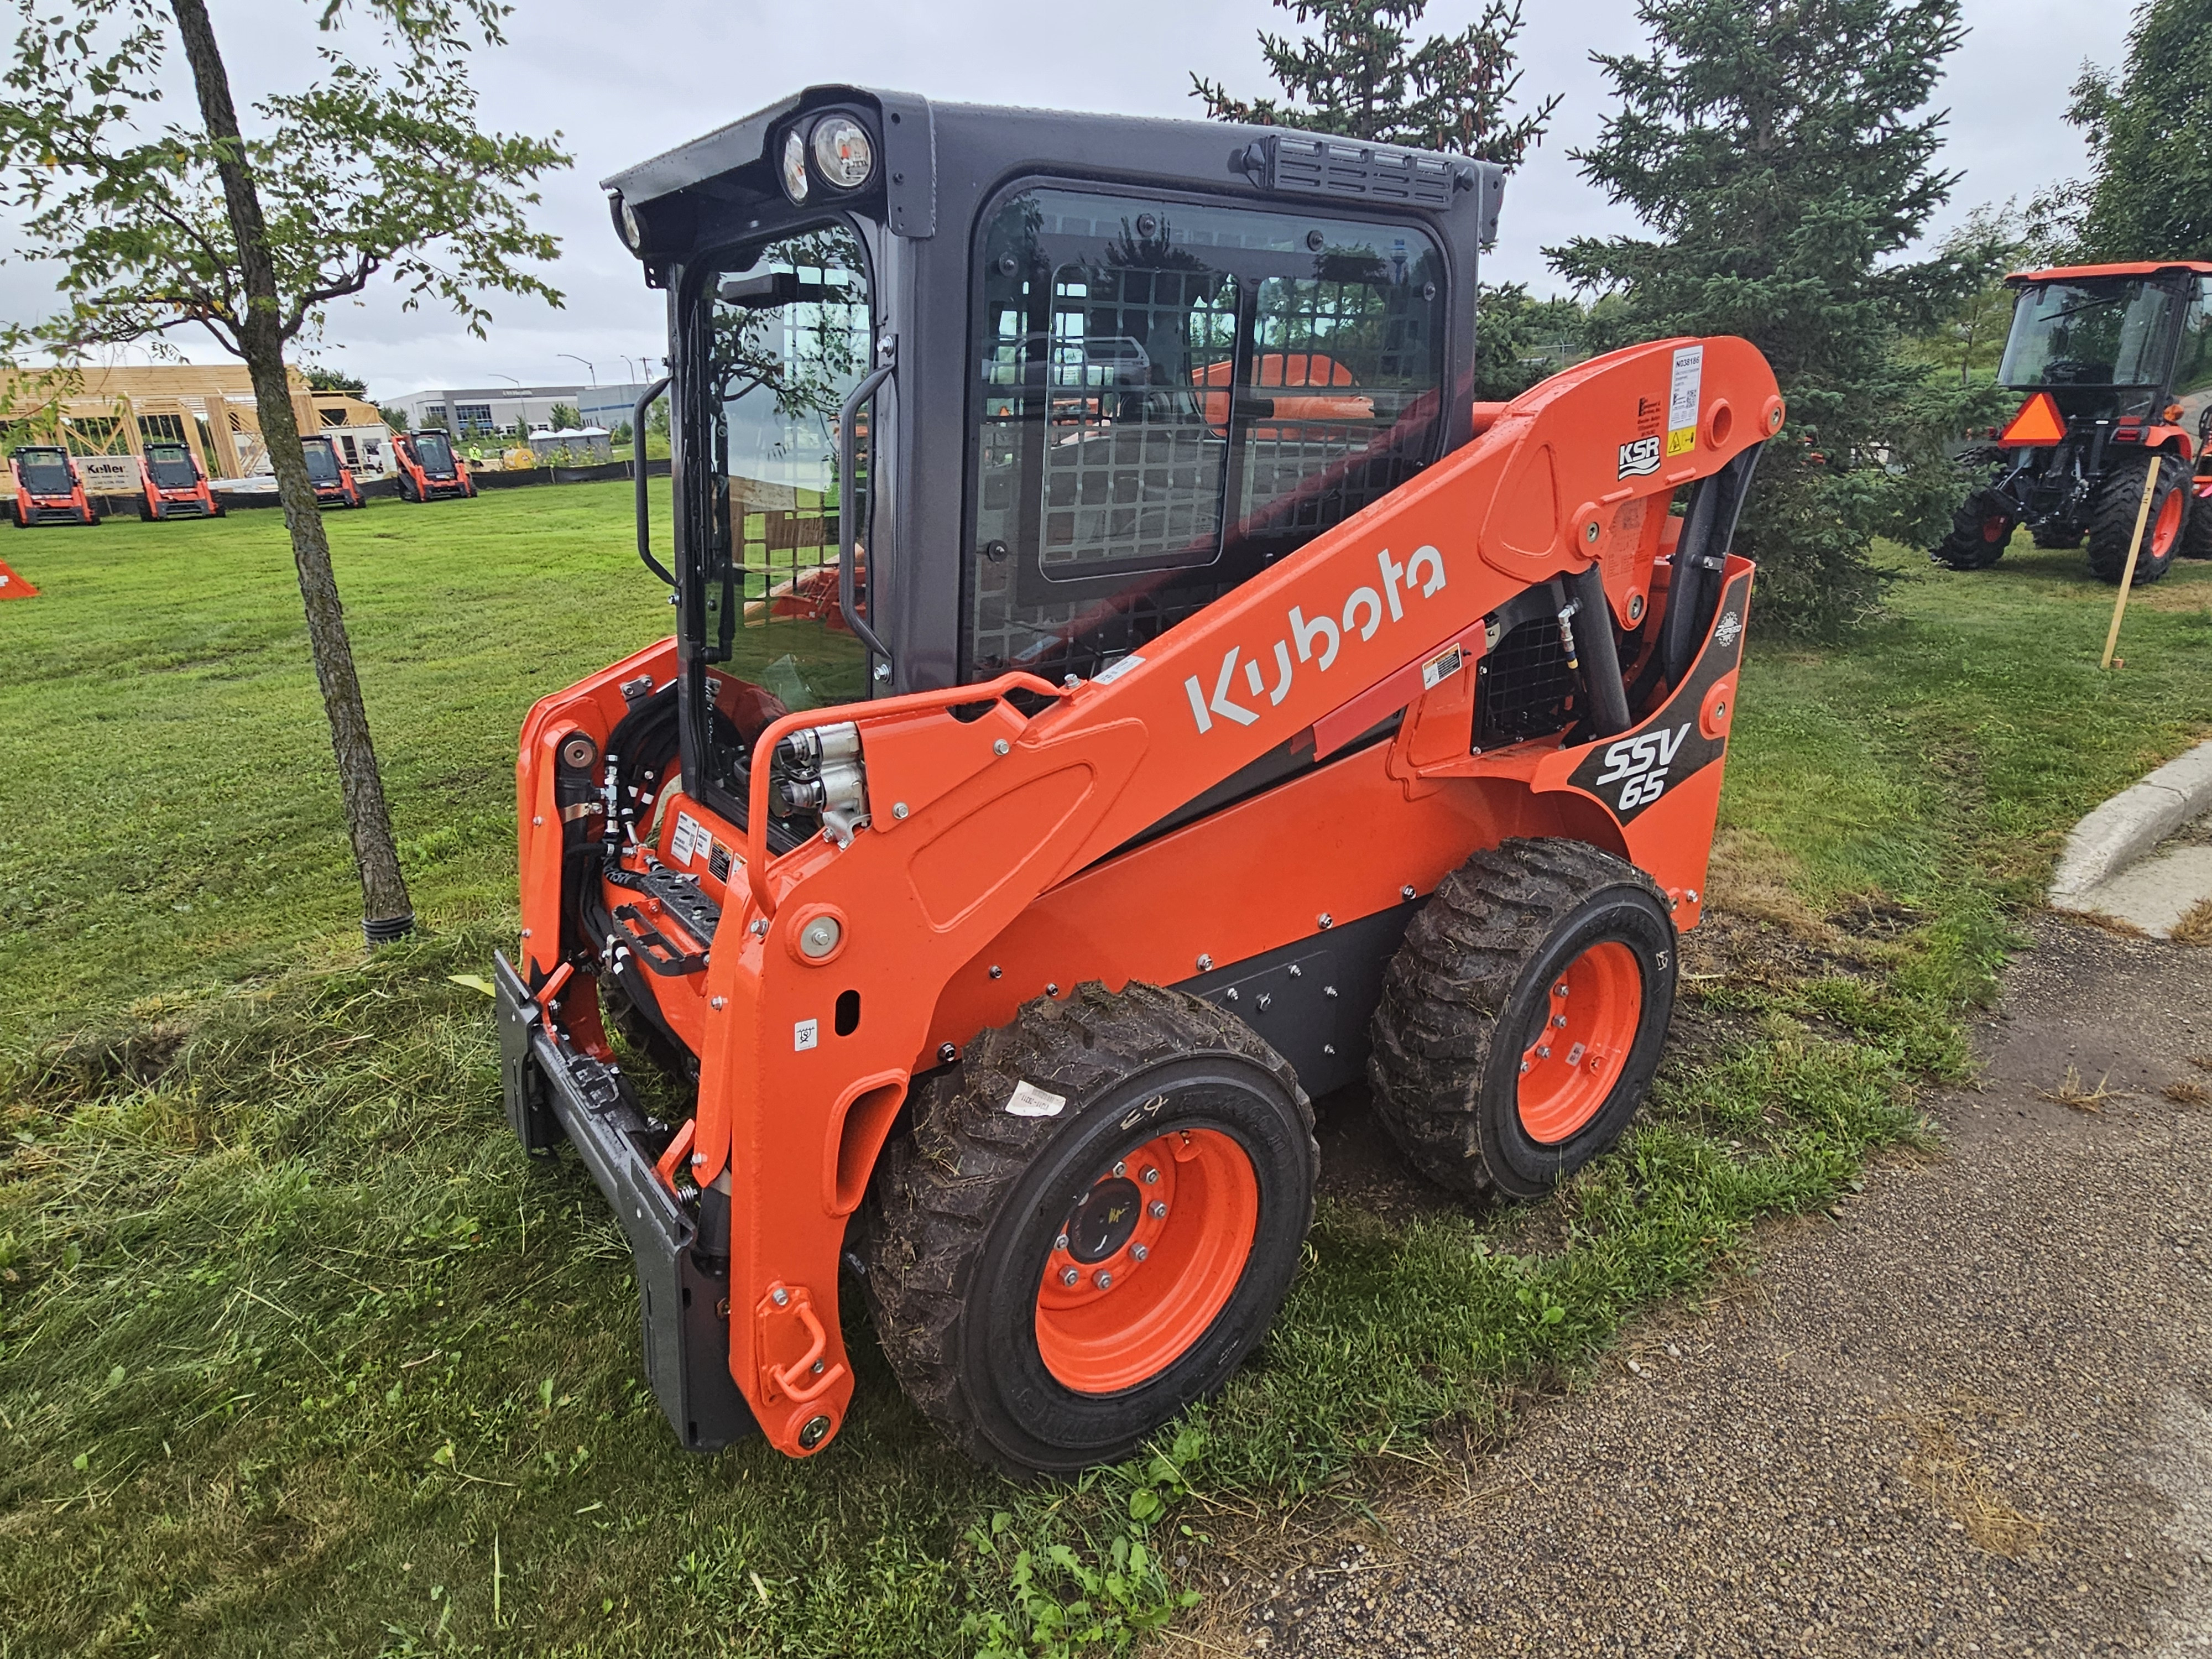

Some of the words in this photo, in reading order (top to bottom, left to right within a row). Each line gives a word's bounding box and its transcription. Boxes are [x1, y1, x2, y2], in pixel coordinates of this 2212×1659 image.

[87, 464, 123, 474] Keller
[1619, 436, 1660, 465] KSR
[1185, 545, 1447, 734] Kubota
[1596, 722, 1692, 786] SSV
[1619, 767, 1669, 810] 65
